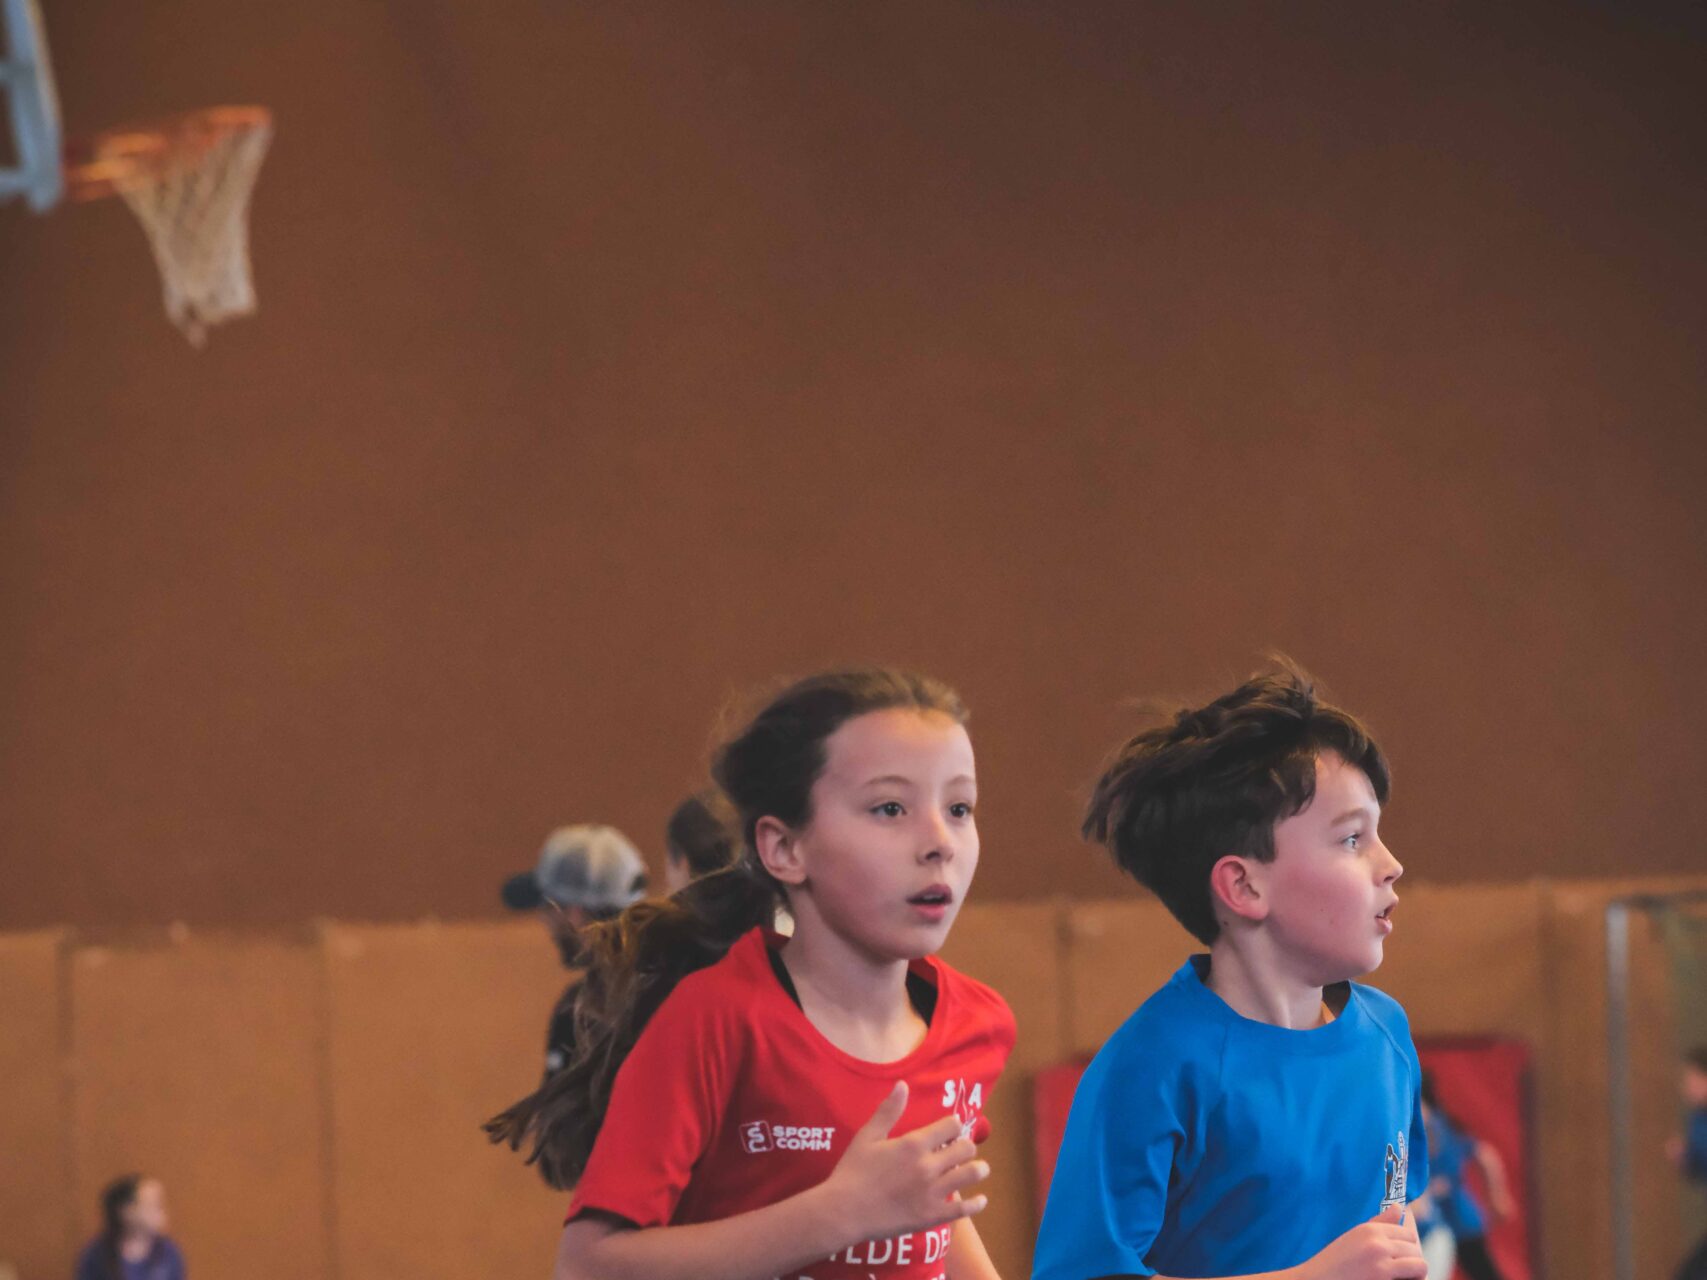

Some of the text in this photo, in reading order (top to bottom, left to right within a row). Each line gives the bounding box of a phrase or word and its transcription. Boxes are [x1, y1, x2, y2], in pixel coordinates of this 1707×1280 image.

[772, 1125, 836, 1139] SPORT
[776, 1137, 831, 1151] COMM
[829, 1228, 949, 1265] LDE DE
